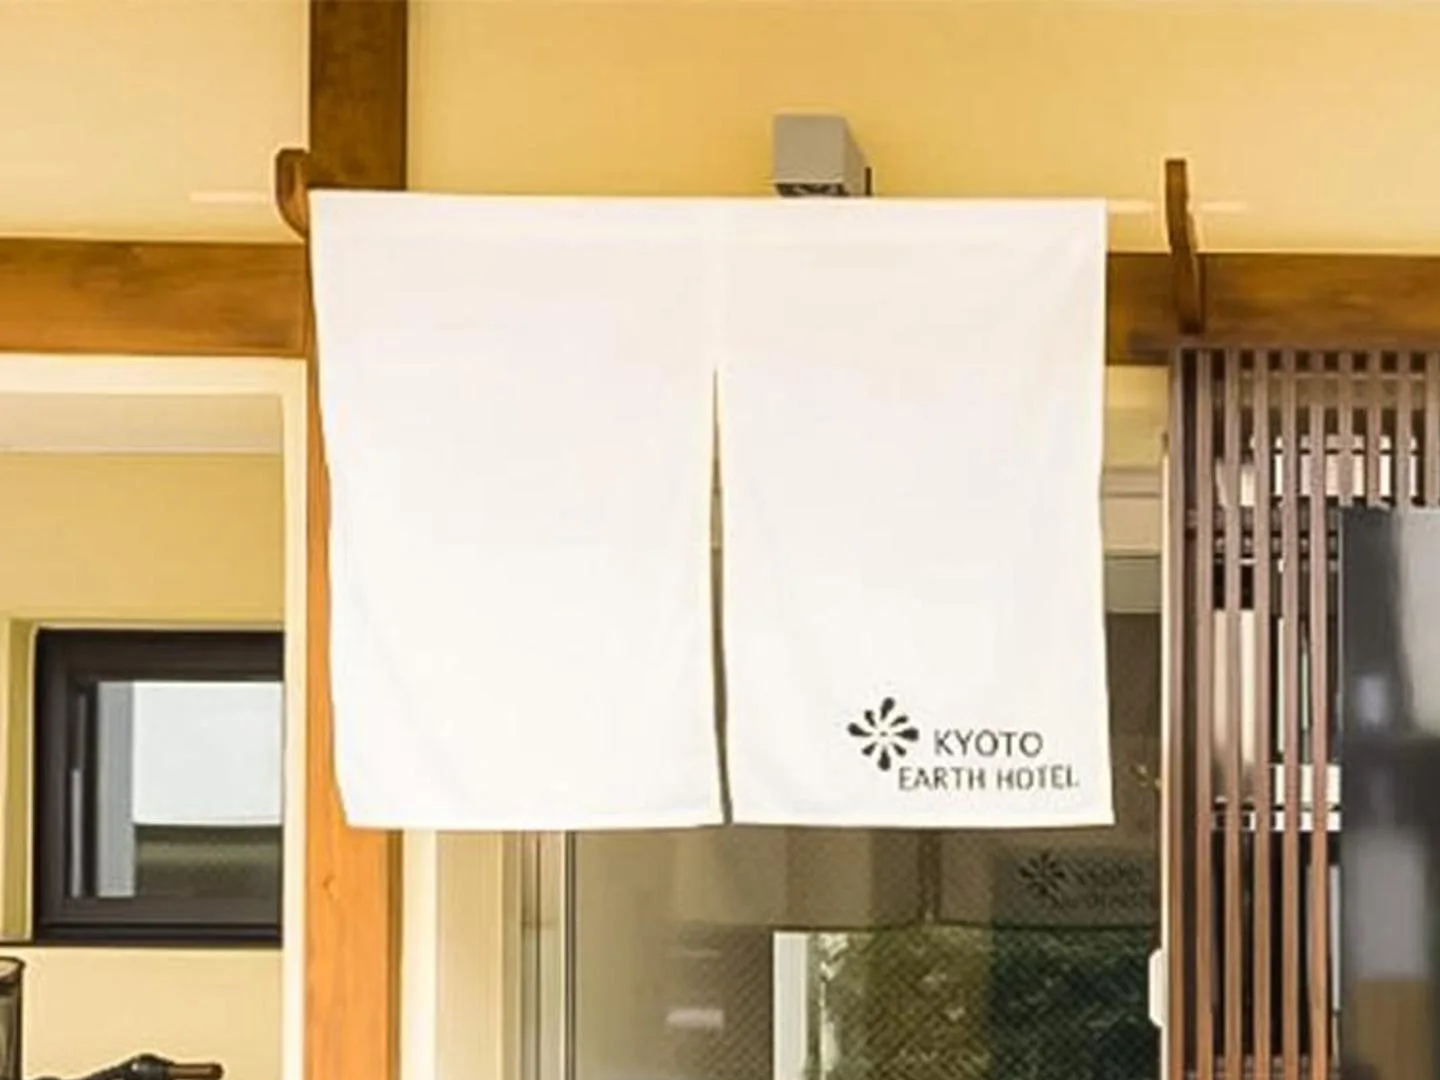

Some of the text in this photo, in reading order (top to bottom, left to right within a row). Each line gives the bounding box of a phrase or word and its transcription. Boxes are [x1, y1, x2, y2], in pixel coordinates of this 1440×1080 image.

[933, 729, 1044, 758] KYOTO
[898, 764, 1079, 791] EARTH HOTEL
